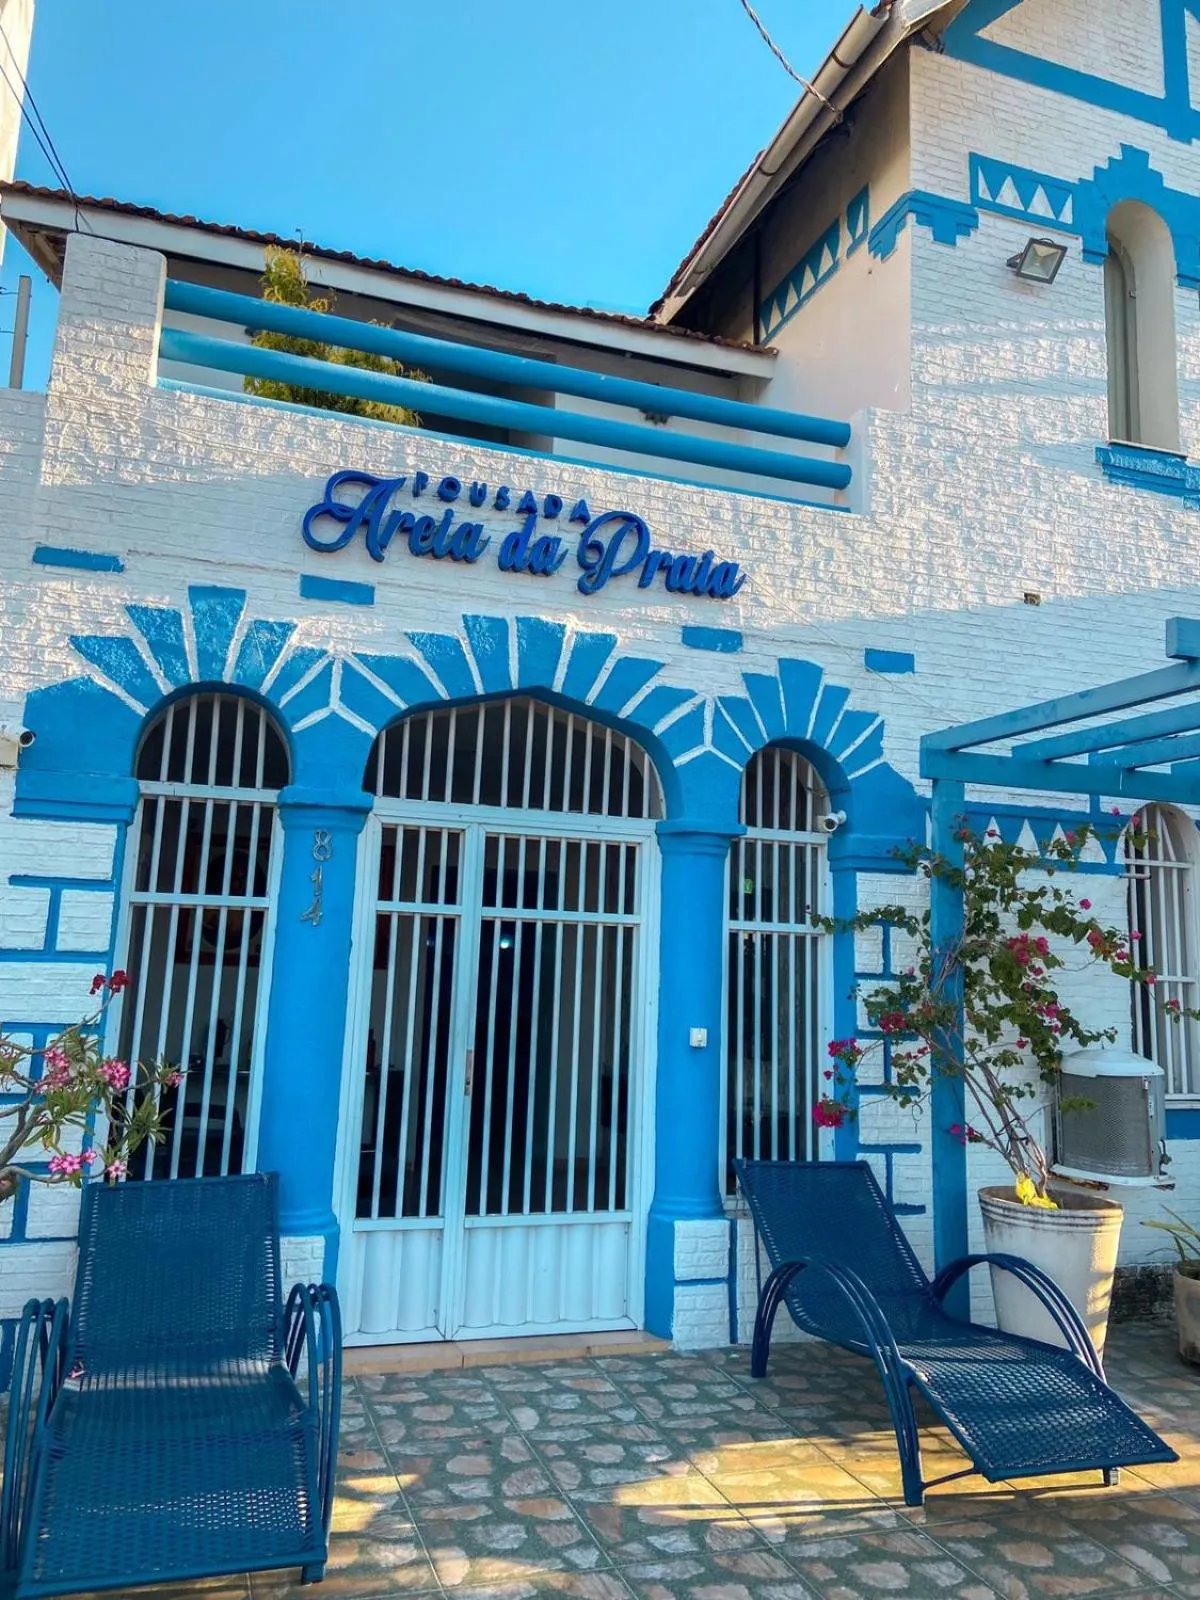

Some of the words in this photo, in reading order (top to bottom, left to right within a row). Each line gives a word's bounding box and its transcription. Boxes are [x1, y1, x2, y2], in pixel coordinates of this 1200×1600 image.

[302, 470, 491, 562] Areia
[498, 514, 569, 577] da
[576, 510, 747, 600] Praia
[412, 471, 591, 524] POUSADA
